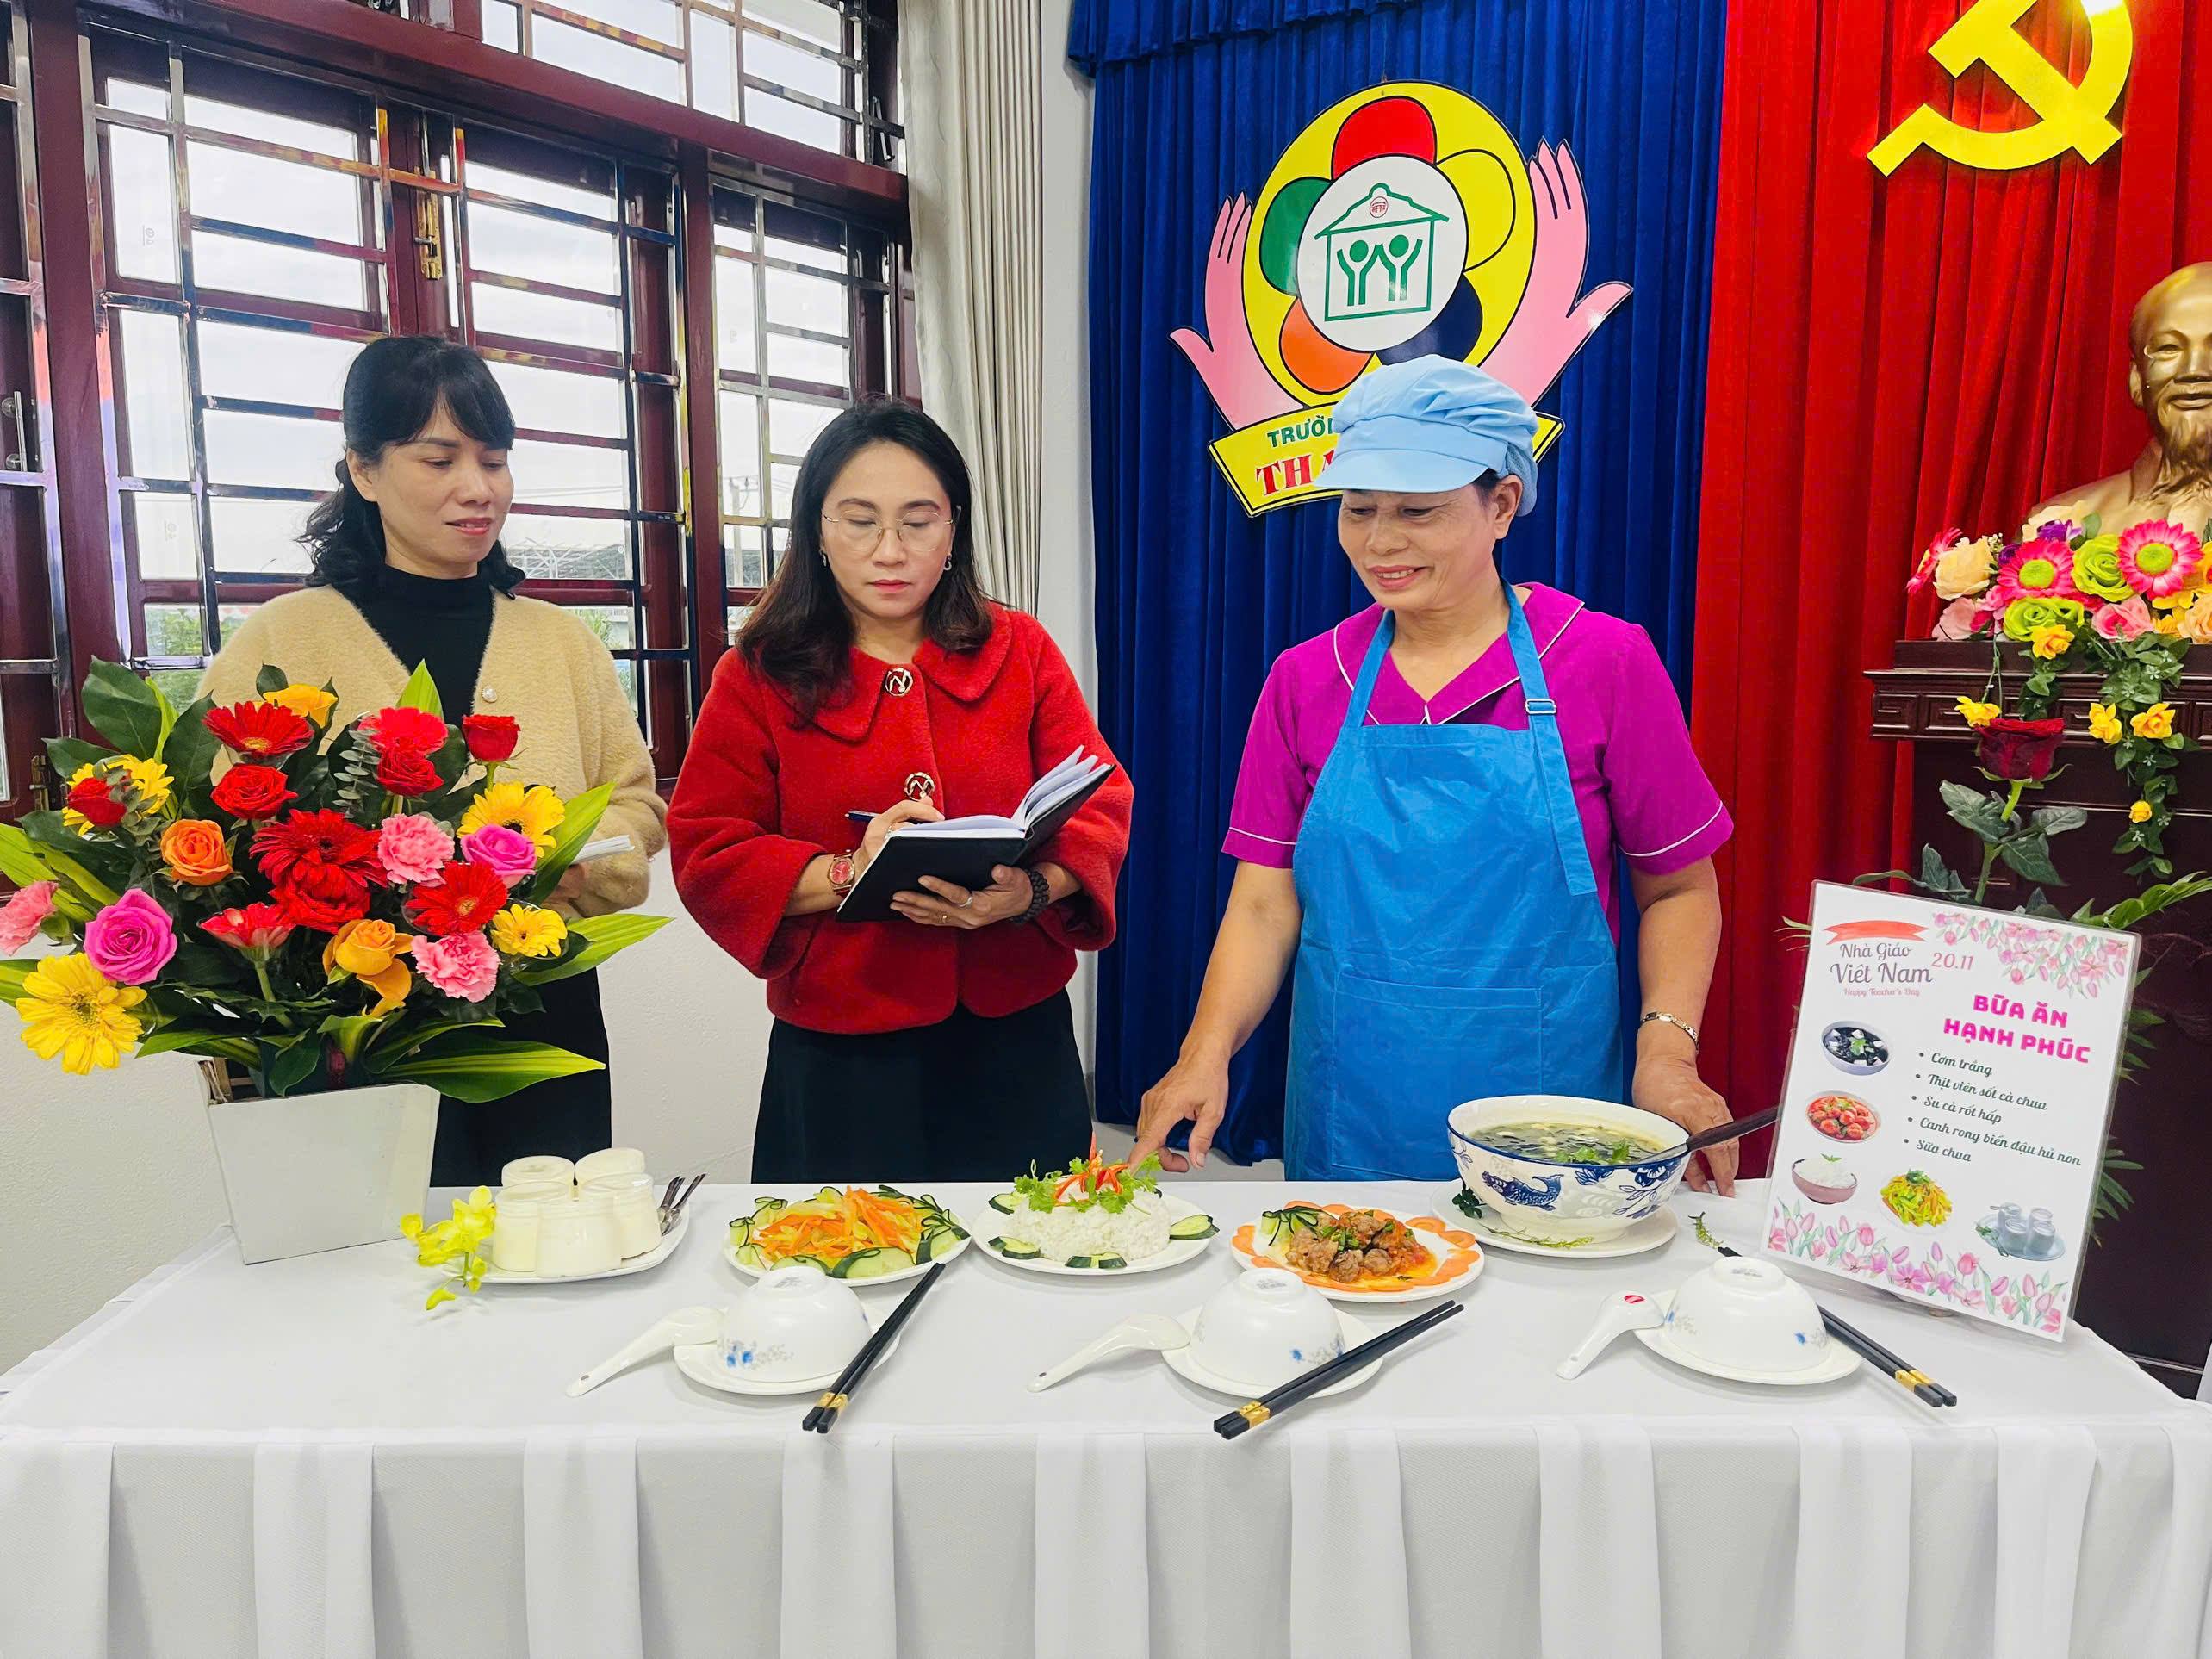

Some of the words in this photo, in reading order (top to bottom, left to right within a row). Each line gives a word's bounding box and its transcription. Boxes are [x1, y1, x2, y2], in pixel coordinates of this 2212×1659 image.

[1840, 943, 1873, 958] Nhà
[1876, 942, 1911, 960] Giáo
[1931, 952, 1974, 971] 20.11
[1877, 962, 1933, 984] Nam
[1844, 988, 1867, 998] Happy
[1904, 988, 1920, 998] Day
[1973, 994, 2025, 1020] BỮA
[2032, 1001, 2068, 1028] ĂN
[1943, 1018, 2014, 1047] HẠNH
[2021, 1034, 2091, 1064] PHÚC
[1931, 1052, 1957, 1067] Cơm
[1959, 1059, 1992, 1078] trắng
[1928, 1073, 1951, 1090] Thịt
[1953, 1082, 1977, 1095] viên
[1979, 1086, 1997, 1099] sốt
[1998, 1091, 2014, 1103] cà
[2016, 1096, 2047, 1110] chua
[1923, 1096, 1940, 1108] Su
[1942, 1101, 1957, 1112] cà
[1958, 1104, 1976, 1117] rốt
[1978, 1109, 2002, 1125] hấp
[1916, 1139, 1940, 1154] Sữa
[1942, 1146, 1972, 1162] chua
[1920, 1117, 1950, 1134] Canh
[1952, 1127, 1980, 1143] rong
[2010, 1140, 2035, 1155] đậu
[2038, 1146, 2054, 1159] hủ
[2056, 1153, 2081, 1166] non
